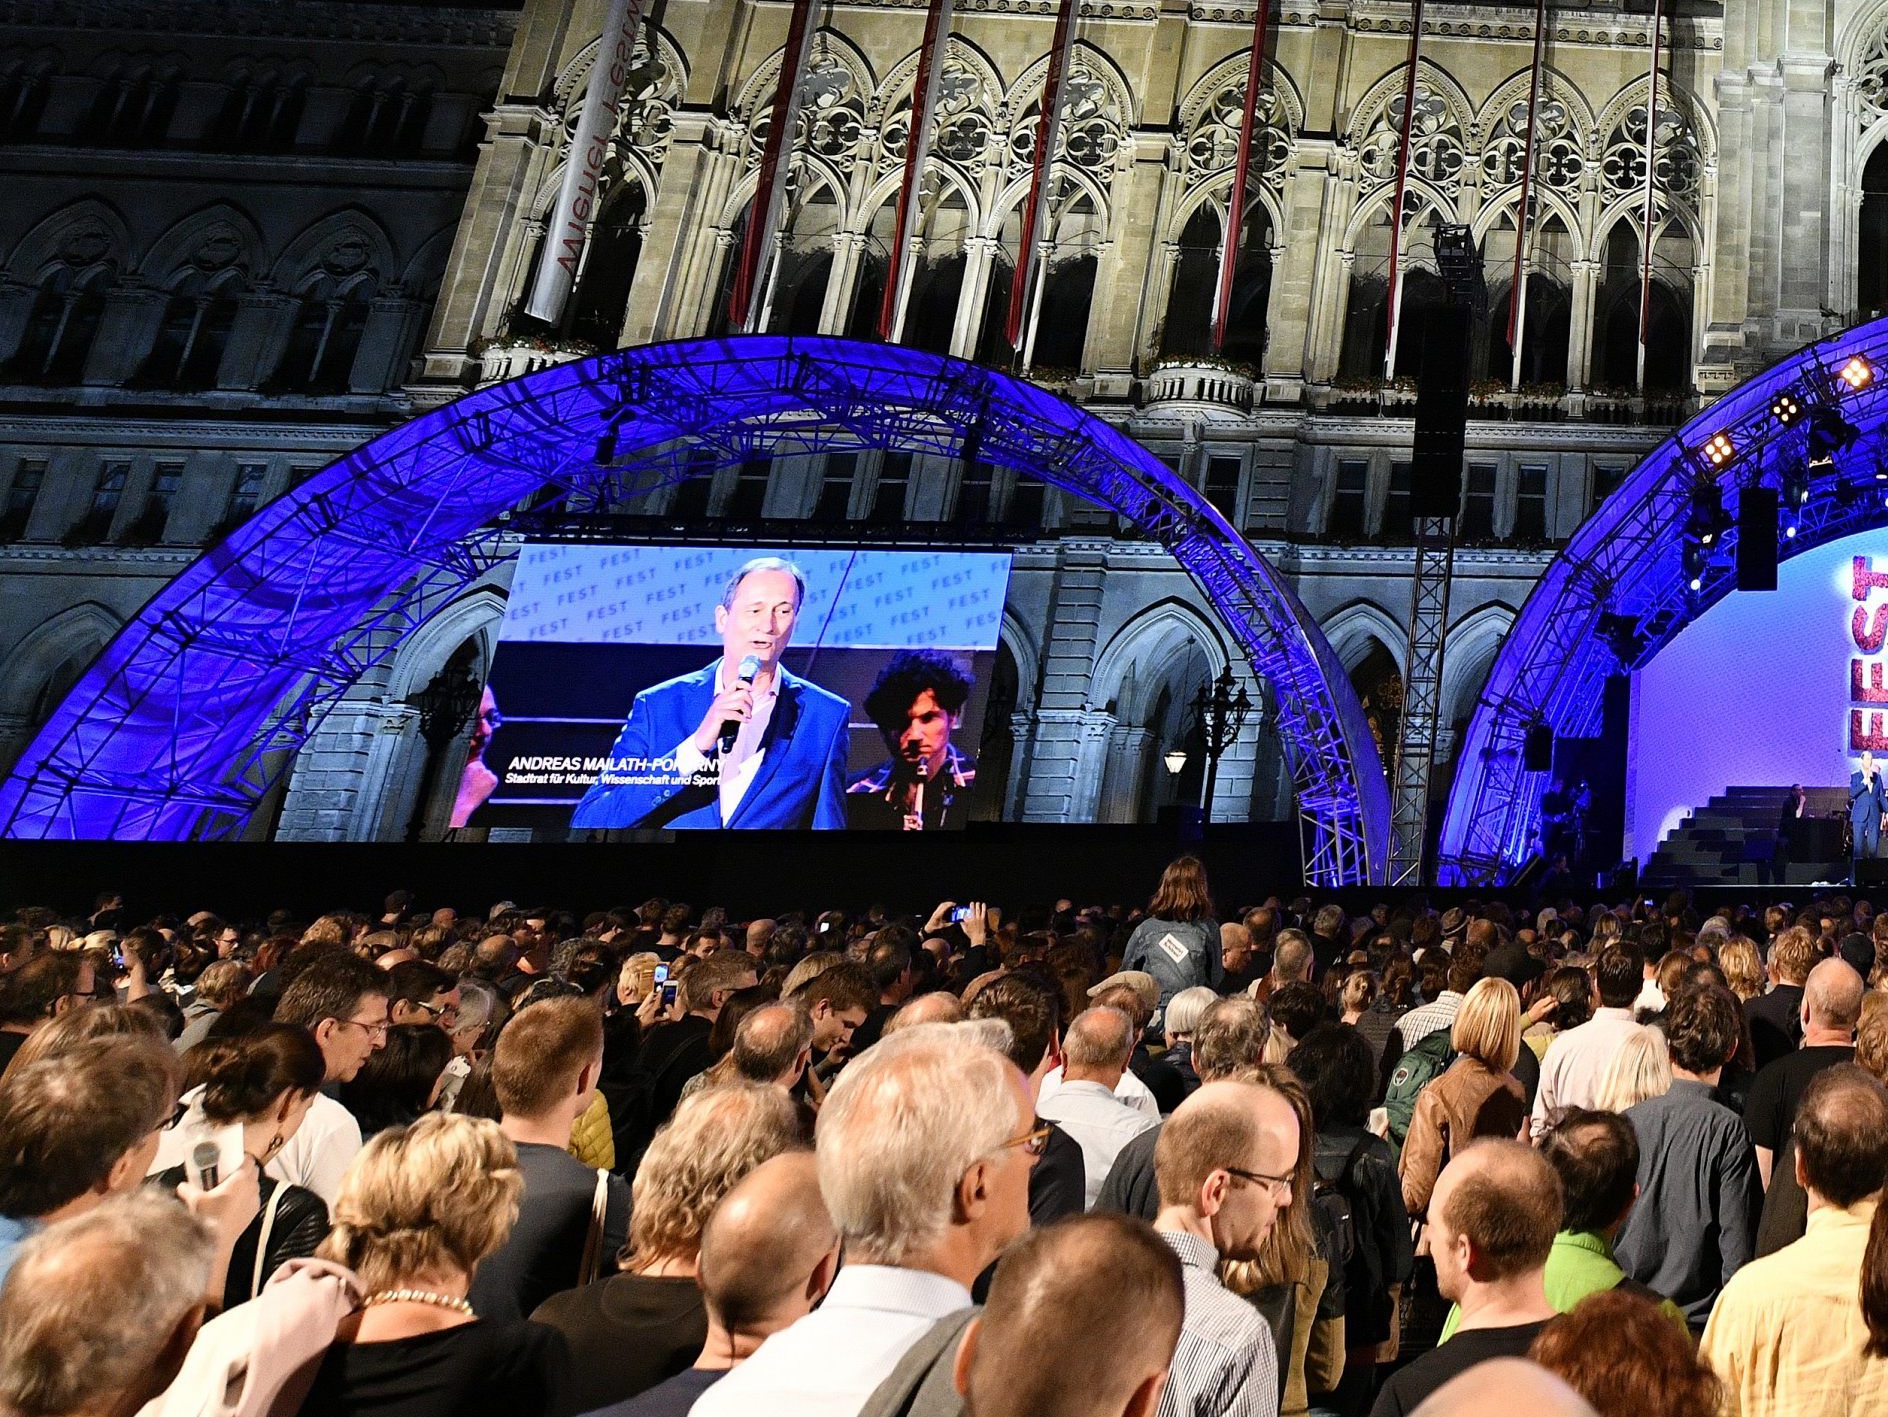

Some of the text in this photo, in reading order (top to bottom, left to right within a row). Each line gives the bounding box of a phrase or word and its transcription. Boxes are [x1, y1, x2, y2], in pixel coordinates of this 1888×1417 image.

[529, 547, 568, 565] FEST
[543, 549, 640, 586] FEST FEST
[829, 553, 868, 573] FEST
[557, 553, 713, 606] FEST FEST FEST
[846, 555, 940, 593] FEST FEST
[587, 569, 734, 622] FEST FEST FES
[875, 586, 914, 608] FEST
[931, 569, 972, 590] FEST
[510, 602, 541, 620] EST
[891, 588, 990, 626] FEST FEST
[530, 618, 568, 637] FEST
[602, 603, 701, 641] FEST FEST
[677, 624, 718, 642] FEST
[834, 623, 872, 643] FEST
[907, 611, 996, 645] FEST FES
[508, 757, 582, 771] ANDREAS
[505, 773, 549, 785] Stadtrat
[549, 773, 564, 785] für
[565, 773, 599, 786] Kultur,
[601, 774, 670, 785] Wissenschaft
[671, 776, 692, 785] und
